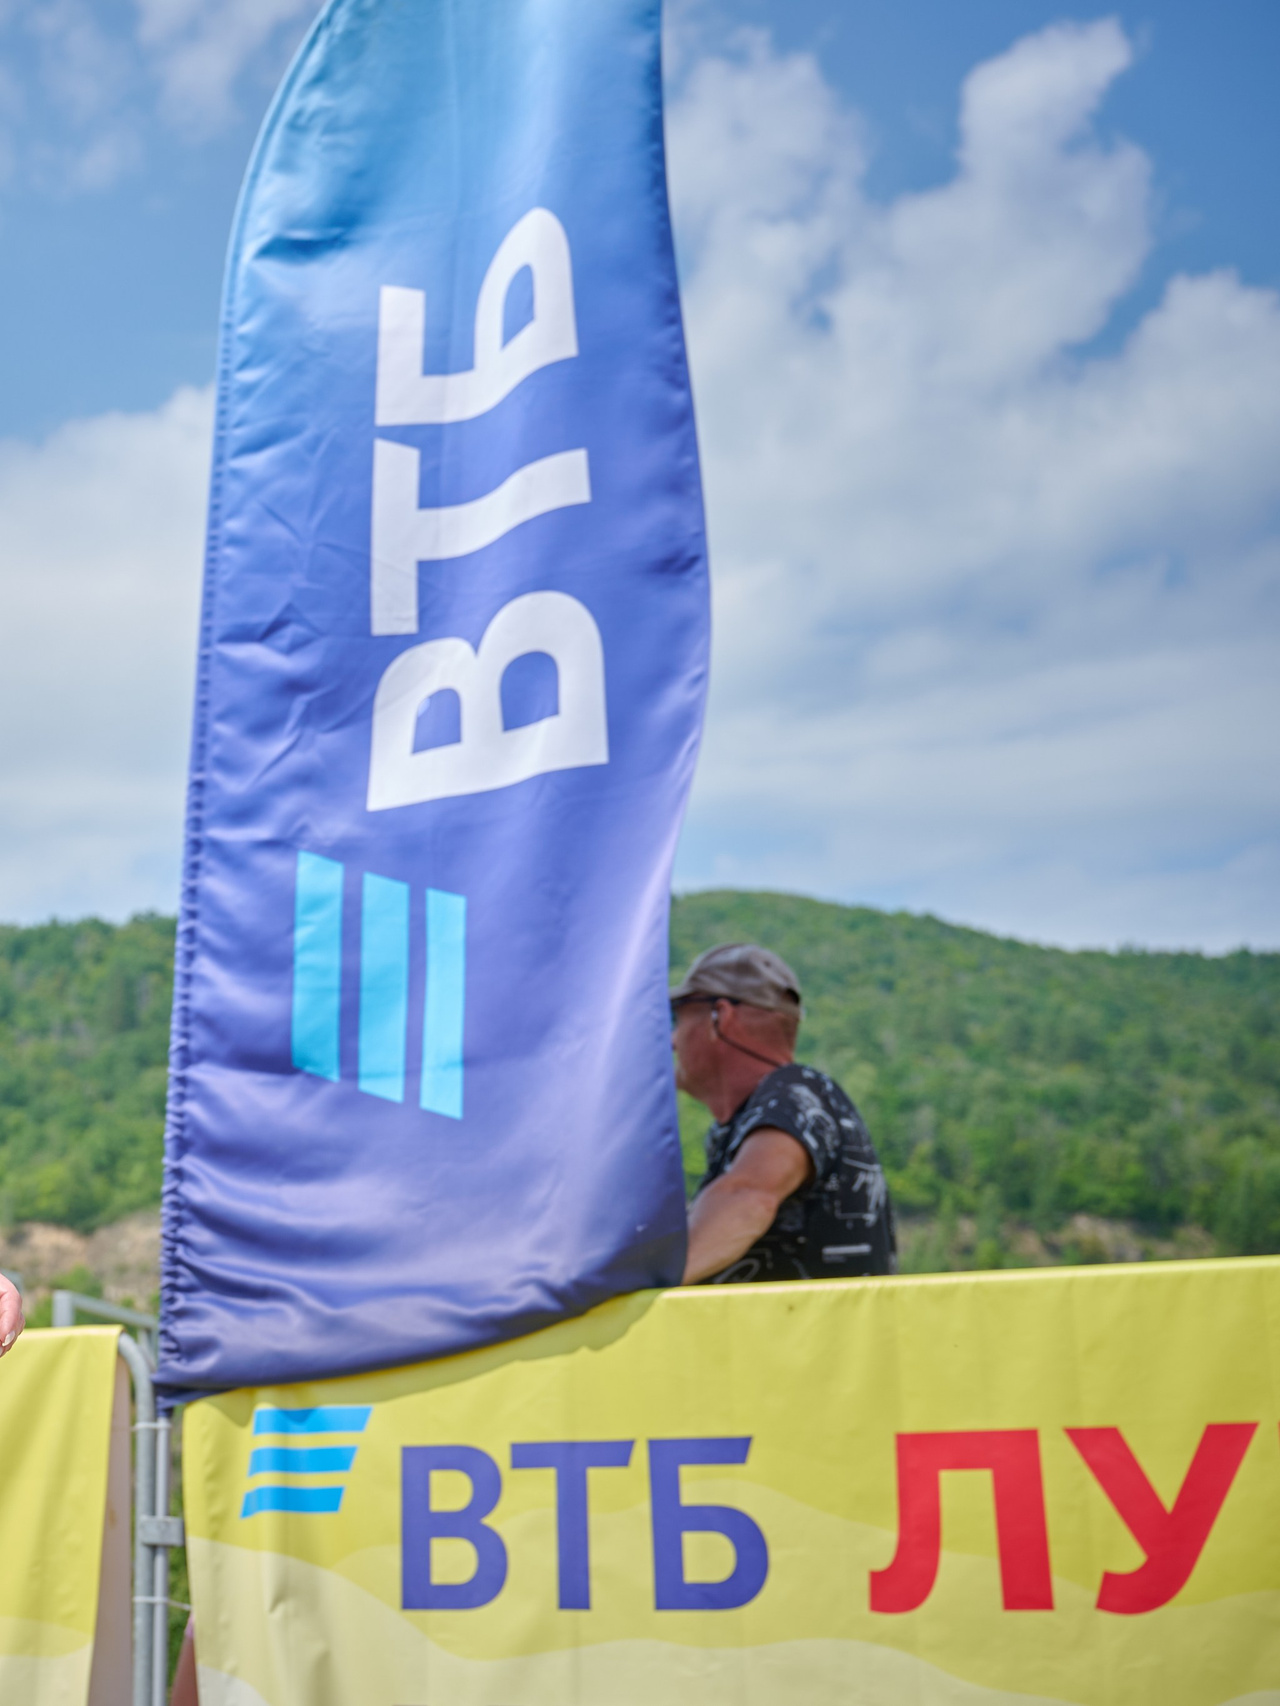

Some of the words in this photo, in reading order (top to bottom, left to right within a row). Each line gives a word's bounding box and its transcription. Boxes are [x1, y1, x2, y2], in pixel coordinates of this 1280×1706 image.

[366, 205, 610, 812] ВТБ
[400, 1435, 770, 1611] ВТБ
[868, 1421, 1280, 1616] ЛУ
